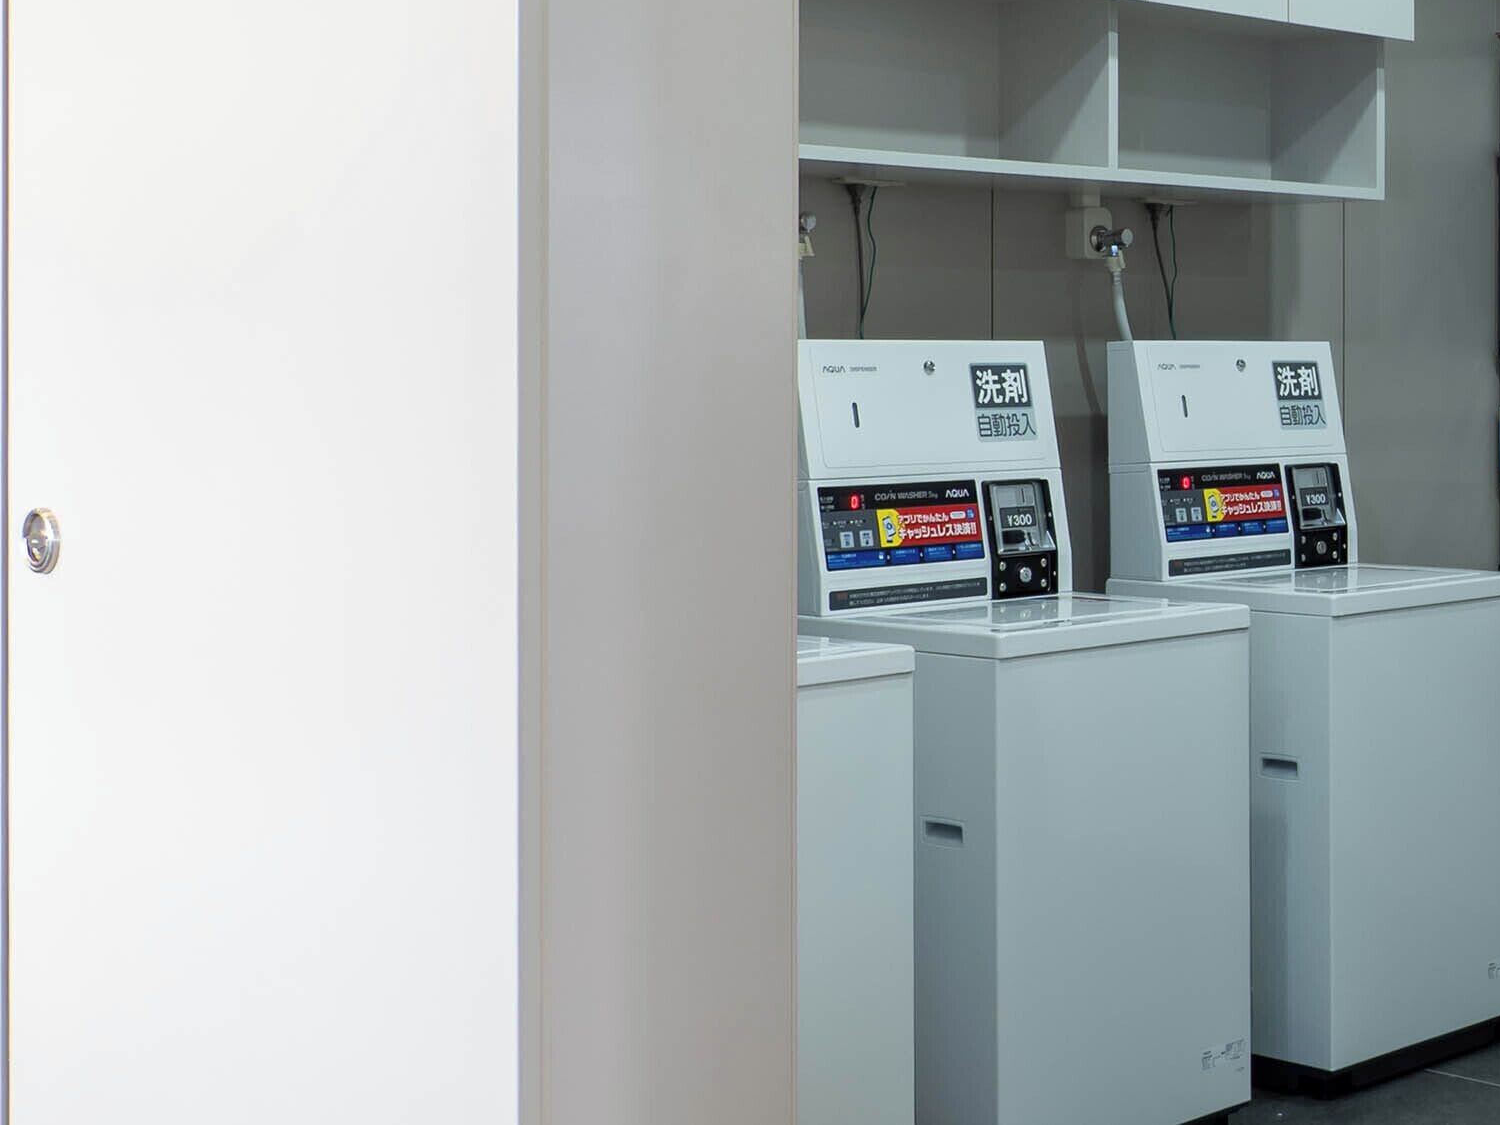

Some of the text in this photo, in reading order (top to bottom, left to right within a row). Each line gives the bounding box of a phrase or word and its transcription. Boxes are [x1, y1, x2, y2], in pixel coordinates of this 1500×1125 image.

[822, 365, 846, 373] AQUA
[976, 369, 1029, 405] 洗剤
[1277, 366, 1320, 397] 洗剤
[1279, 404, 1326, 426] 自動投入
[977, 413, 1036, 438] 自動投入
[850, 494, 860, 510] 0
[897, 491, 928, 500] WASHER
[945, 489, 970, 498] AQUA
